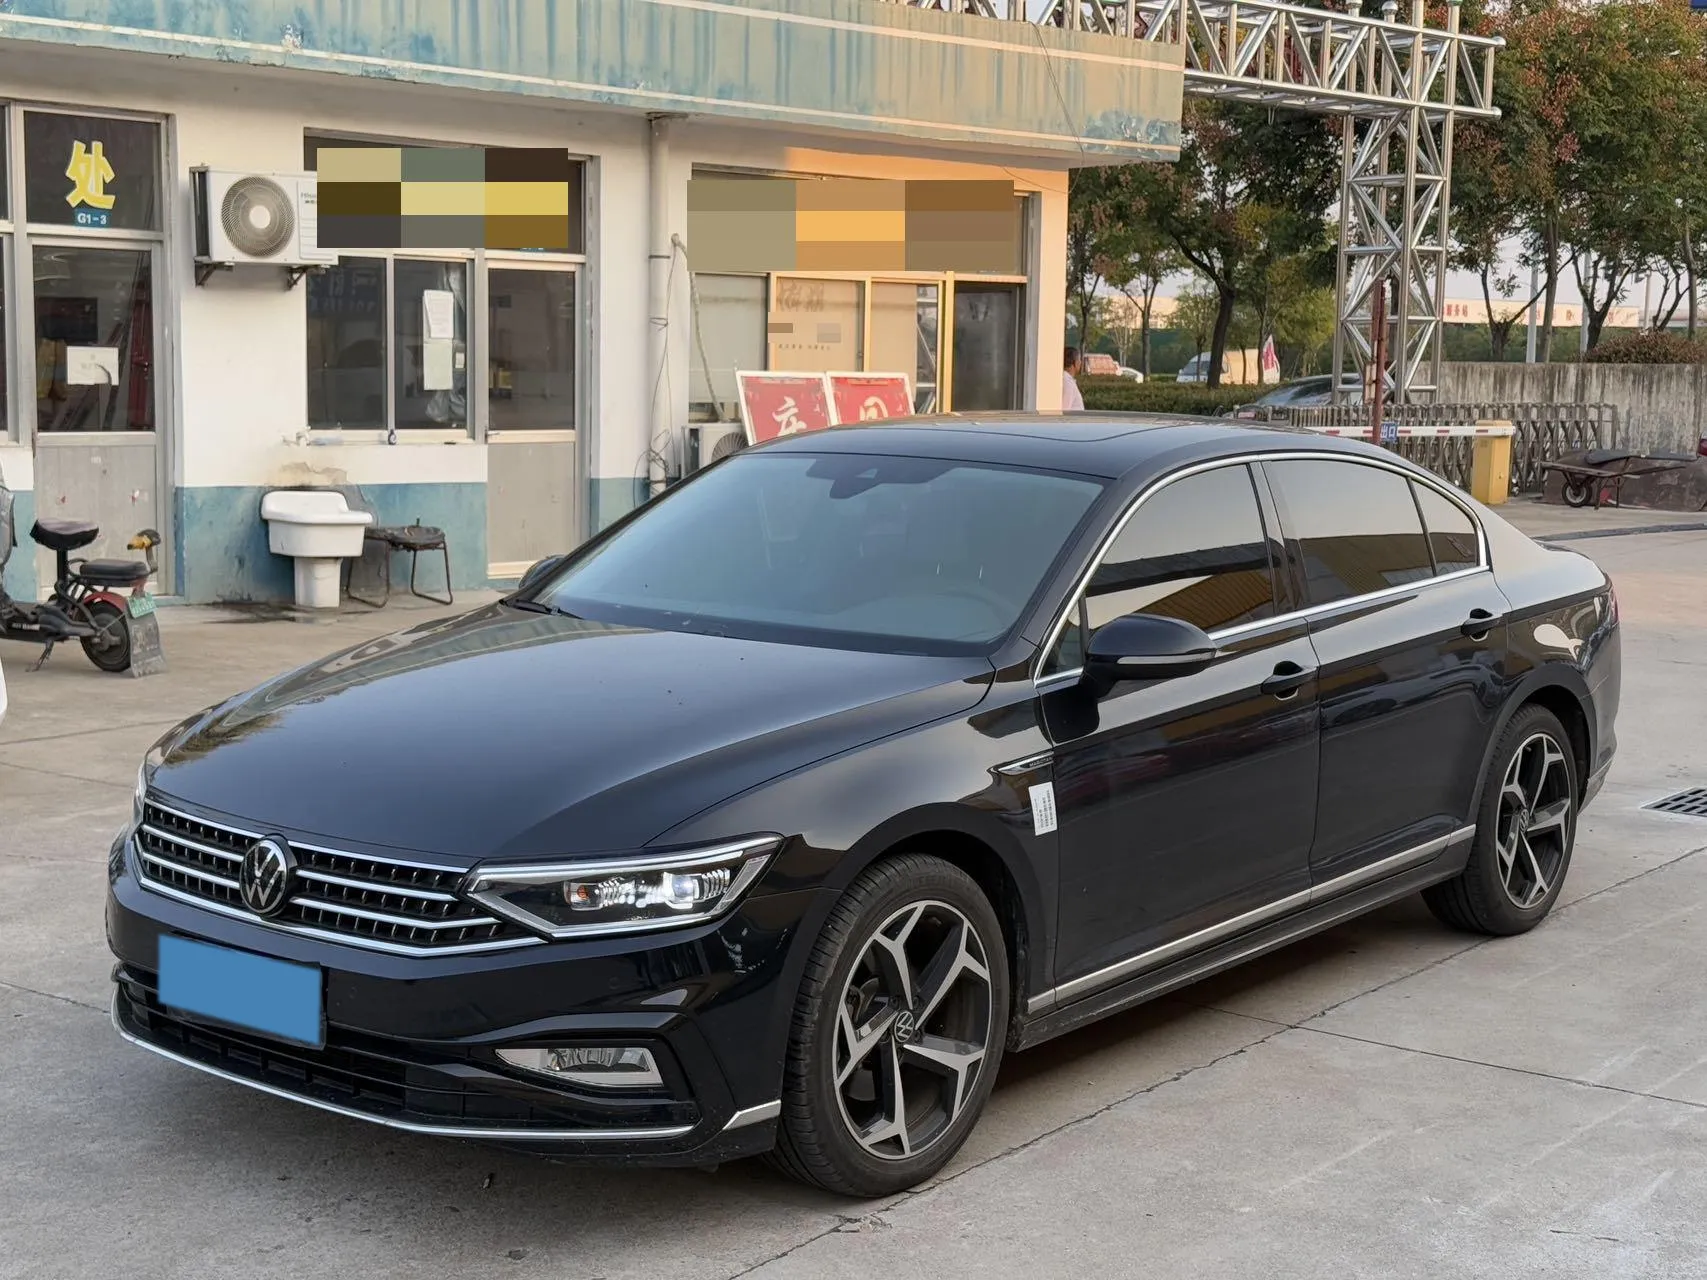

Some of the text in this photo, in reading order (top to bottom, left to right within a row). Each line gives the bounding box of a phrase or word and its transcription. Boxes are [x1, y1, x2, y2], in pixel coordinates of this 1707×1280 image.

[65, 140, 116, 210] 处
[77, 212, 107, 225] G1-3
[1443, 303, 1469, 318] 服务站
